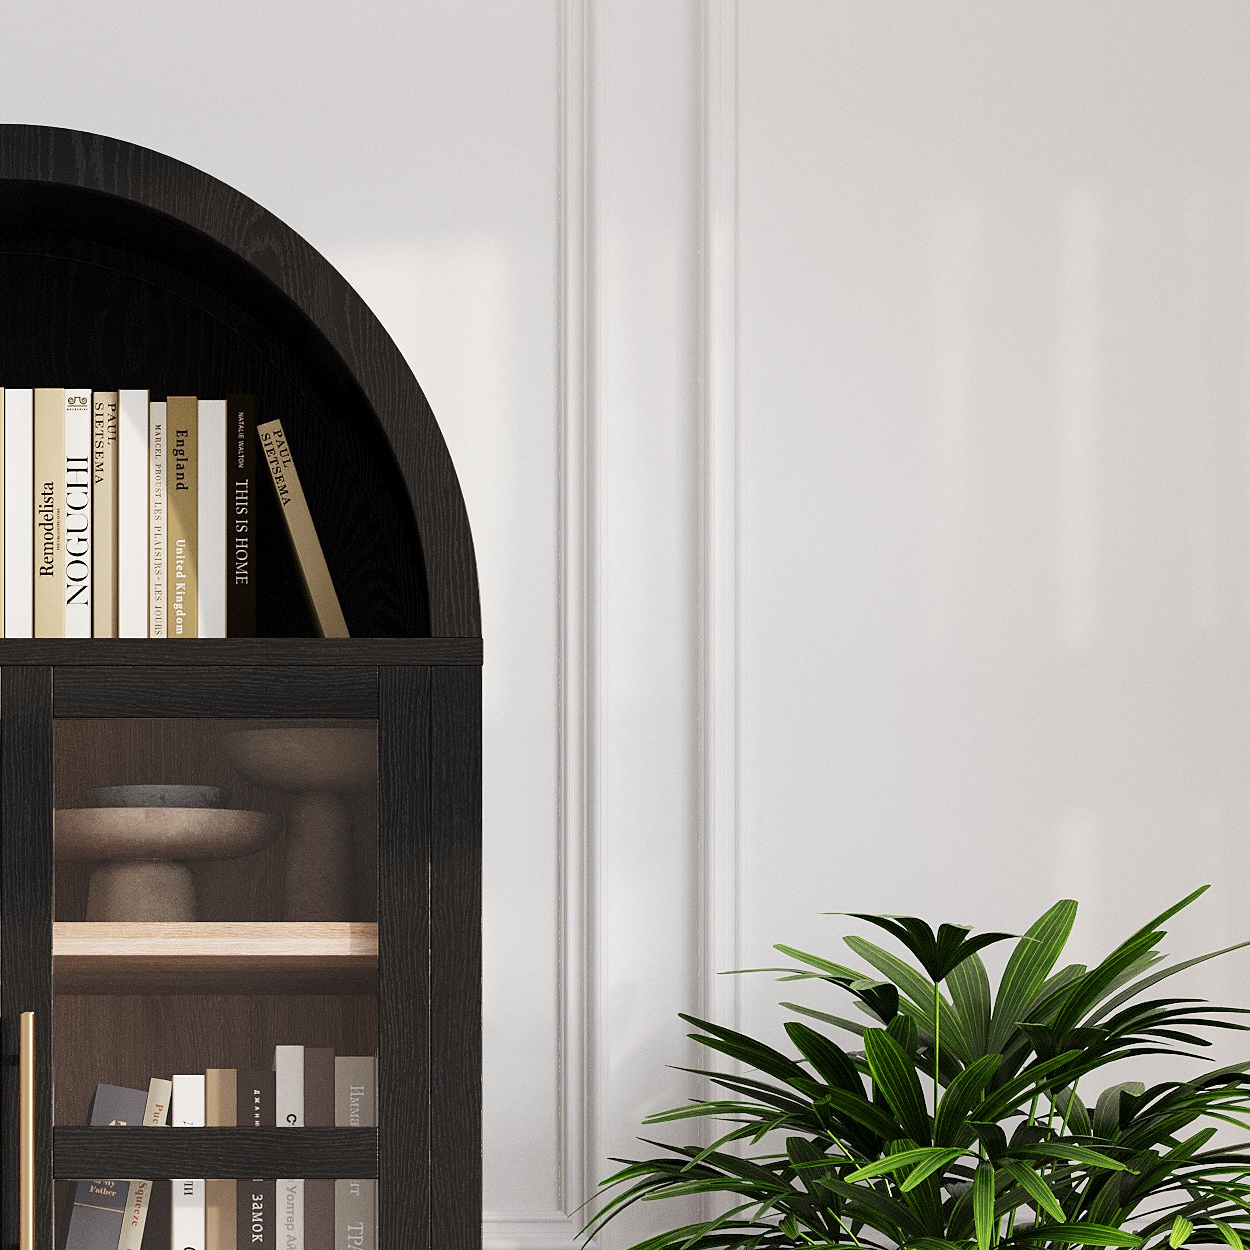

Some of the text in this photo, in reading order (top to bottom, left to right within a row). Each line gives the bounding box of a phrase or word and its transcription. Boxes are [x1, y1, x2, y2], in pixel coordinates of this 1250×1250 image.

[95, 402, 104, 484] SIETSEMA
[107, 403, 116, 445] PAUL
[173, 430, 188, 491] England
[261, 433, 291, 506] SIETSEMA
[273, 429, 292, 467] PAUL
[39, 482, 54, 577] Remodelista
[66, 456, 88, 606] NOGUCHI
[154, 502, 162, 521] LES
[235, 479, 248, 585] THIS IS HOME
[173, 539, 185, 634] United Kingdom
[153, 1104, 163, 1124] Pue
[350, 1085, 364, 1126] Имма
[89, 1185, 117, 1196] Father
[132, 1182, 147, 1227] Squeeze
[285, 1186, 297, 1231] Уолтер
[252, 1194, 264, 1243] замок
